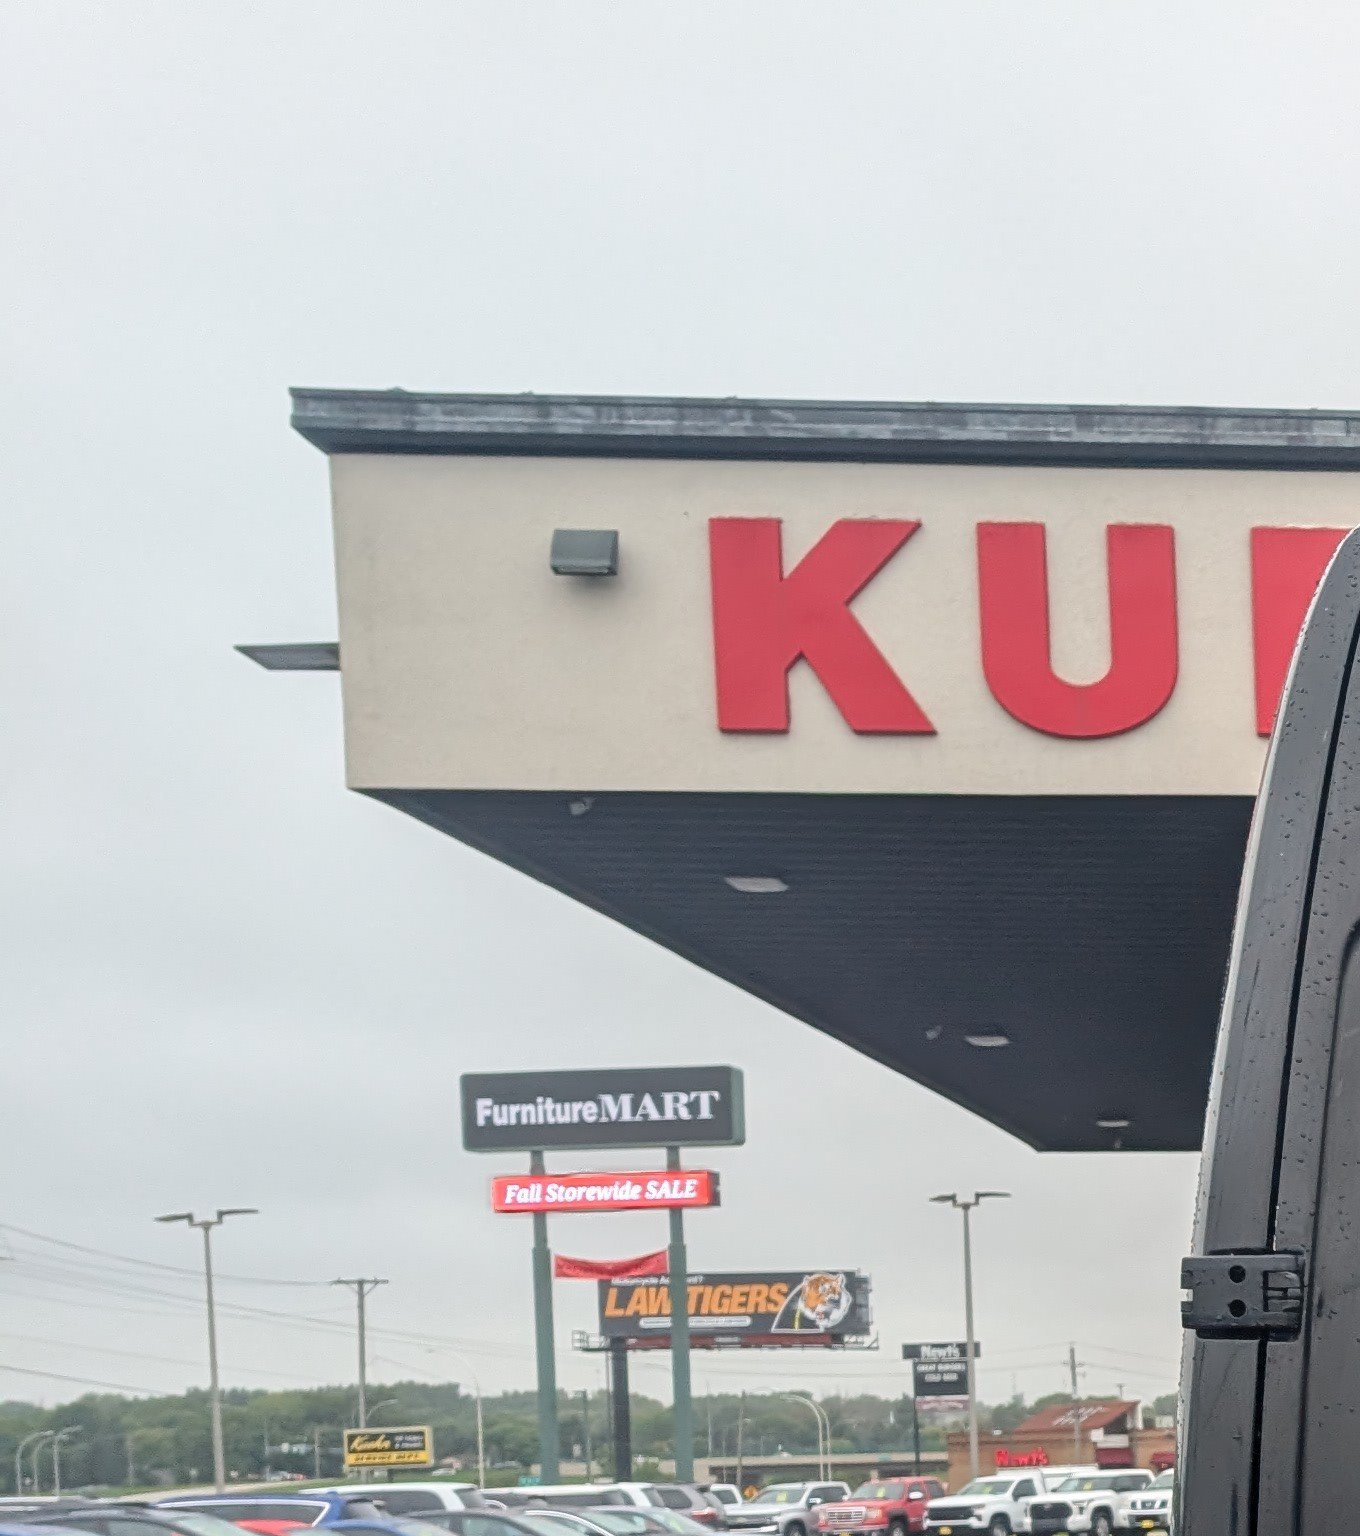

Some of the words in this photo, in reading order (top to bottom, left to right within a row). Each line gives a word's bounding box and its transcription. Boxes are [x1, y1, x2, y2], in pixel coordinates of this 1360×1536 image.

[475, 1090, 720, 1127] FurnitureMART
[505, 1184, 542, 1204] Fall
[545, 1180, 641, 1202] Storewide
[644, 1178, 698, 1200] SALE
